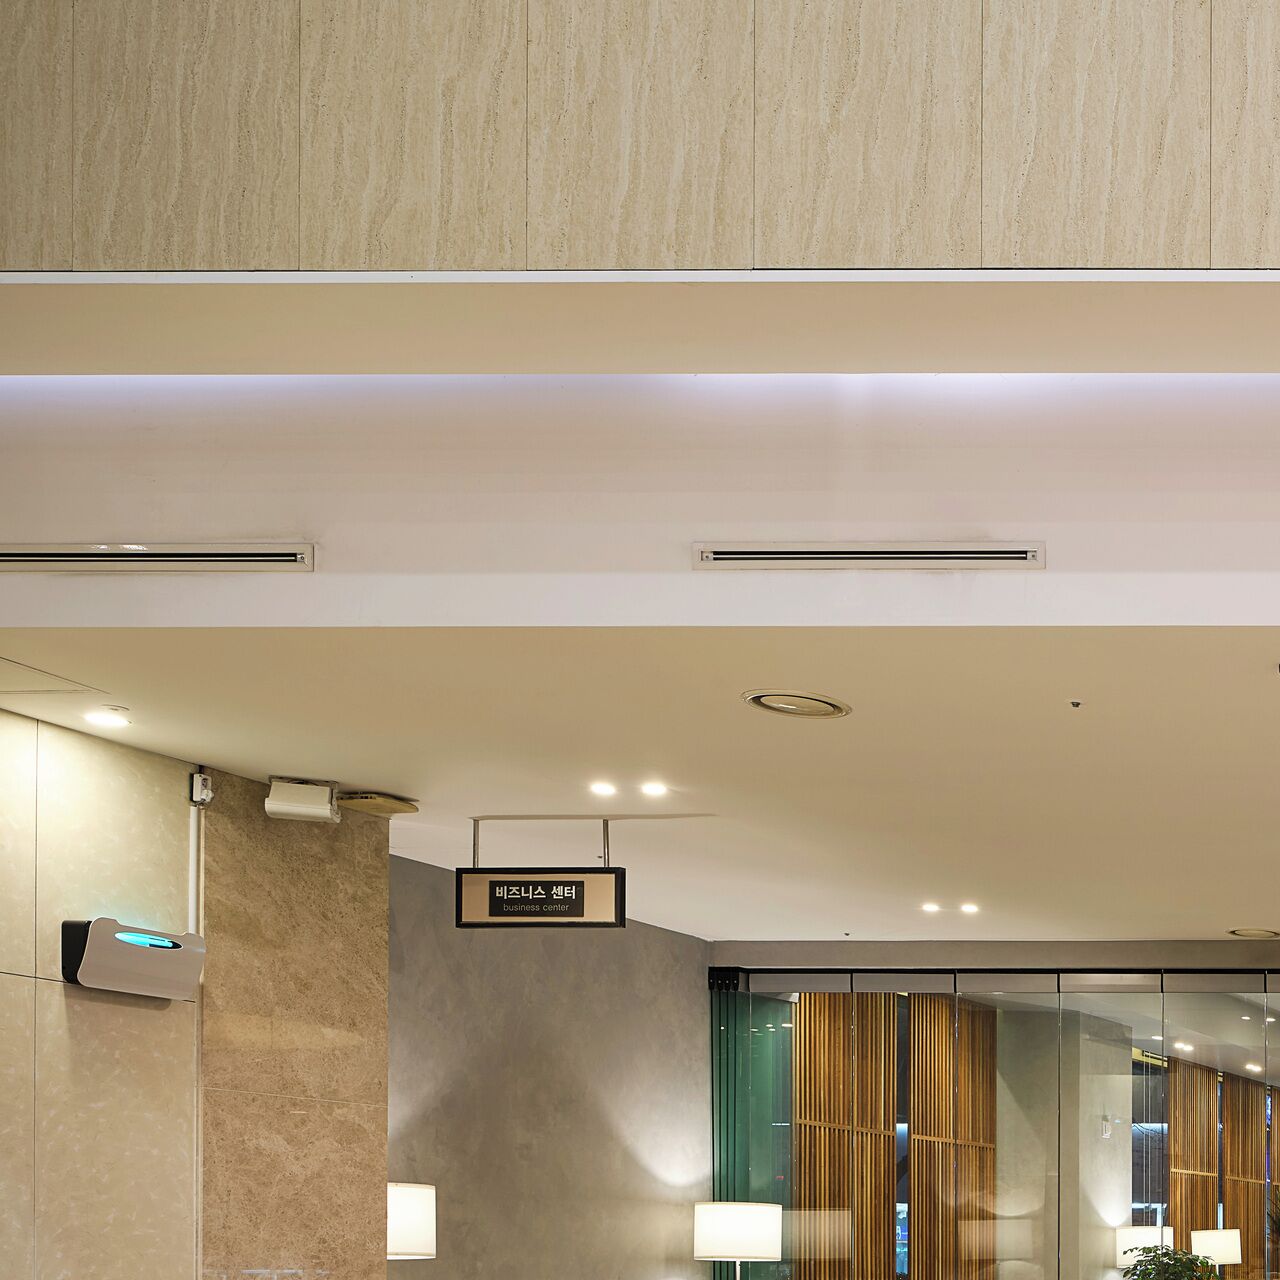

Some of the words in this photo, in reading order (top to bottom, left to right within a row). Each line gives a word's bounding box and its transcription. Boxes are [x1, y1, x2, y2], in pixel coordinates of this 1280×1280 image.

[495, 885, 546, 900] 비즈니스
[551, 885, 576, 900] 센터
[503, 903, 540, 912] business
[542, 903, 569, 912] center
